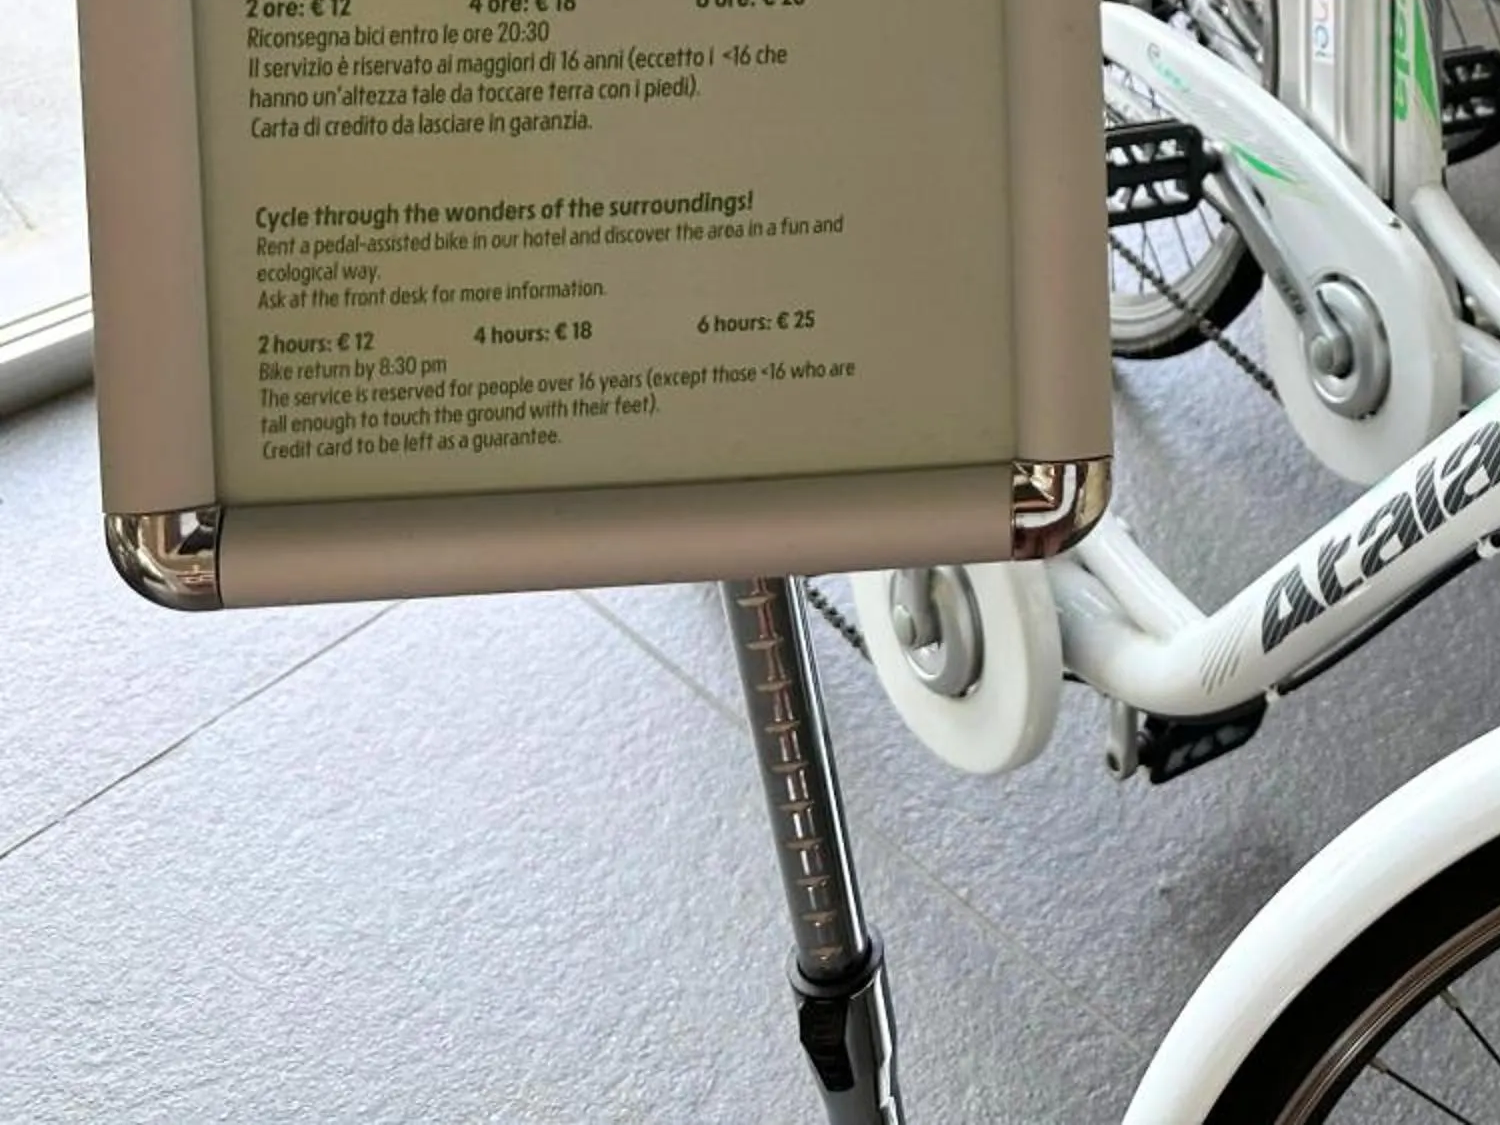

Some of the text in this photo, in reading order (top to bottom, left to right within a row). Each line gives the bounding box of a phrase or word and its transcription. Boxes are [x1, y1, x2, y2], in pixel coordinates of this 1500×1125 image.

[263, 0, 305, 17] ore:
[248, 22, 550, 51] Riconsegna bici entro le ore 20:30
[249, 58, 259, 78] Il
[263, 57, 333, 78] servizio
[337, 55, 349, 76] è
[353, 55, 433, 75] riservato
[437, 54, 453, 73] ai
[457, 52, 534, 78] maggiori
[539, 50, 556, 71] di
[561, 50, 579, 71] 16
[583, 51, 623, 70] anni
[628, 47, 705, 72] (eccetto
[756, 44, 788, 65] che
[249, 88, 308, 108] hanno
[412, 83, 446, 103] tale
[451, 83, 473, 103] da
[477, 82, 543, 102] toccare
[549, 79, 594, 100] terra
[598, 81, 631, 99] con
[251, 110, 592, 138] Carta di credito da lasciare garanzia.
[255, 190, 754, 232] Cycle through the wonders of the surroundings!
[256, 215, 844, 258] Rent pedal-assisted bike hotel and discover the area fun and
[257, 262, 380, 286] ecological way.
[257, 280, 608, 310] Ask the front desk for more information.
[474, 325, 486, 345] 4
[491, 324, 550, 344] hours:
[573, 321, 592, 340] 18
[697, 315, 710, 334] 6
[714, 315, 773, 333] hours:
[793, 310, 815, 329] 25
[258, 335, 270, 355] 2
[273, 334, 332, 354] hours:
[355, 331, 374, 351] 12
[259, 356, 447, 381] Bike return by 8:30 pm
[260, 388, 290, 408] The
[294, 387, 351, 407] service
[371, 380, 445, 402] reserved
[449, 378, 473, 398] for
[477, 377, 533, 400] people
[537, 377, 573, 393] over
[579, 373, 595, 391] 16
[600, 372, 642, 394] years
[646, 368, 707, 390] (except
[712, 363, 757, 383] those
[791, 360, 826, 379] who
[829, 361, 855, 376] are
[260, 415, 288, 434] tall
[291, 412, 356, 435] enough
[383, 408, 430, 426] touch
[433, 404, 463, 424] the
[467, 402, 525, 426] ground
[529, 399, 568, 419] with
[572, 398, 610, 417] their
[263, 429, 562, 459] Credit card left guarantee.
